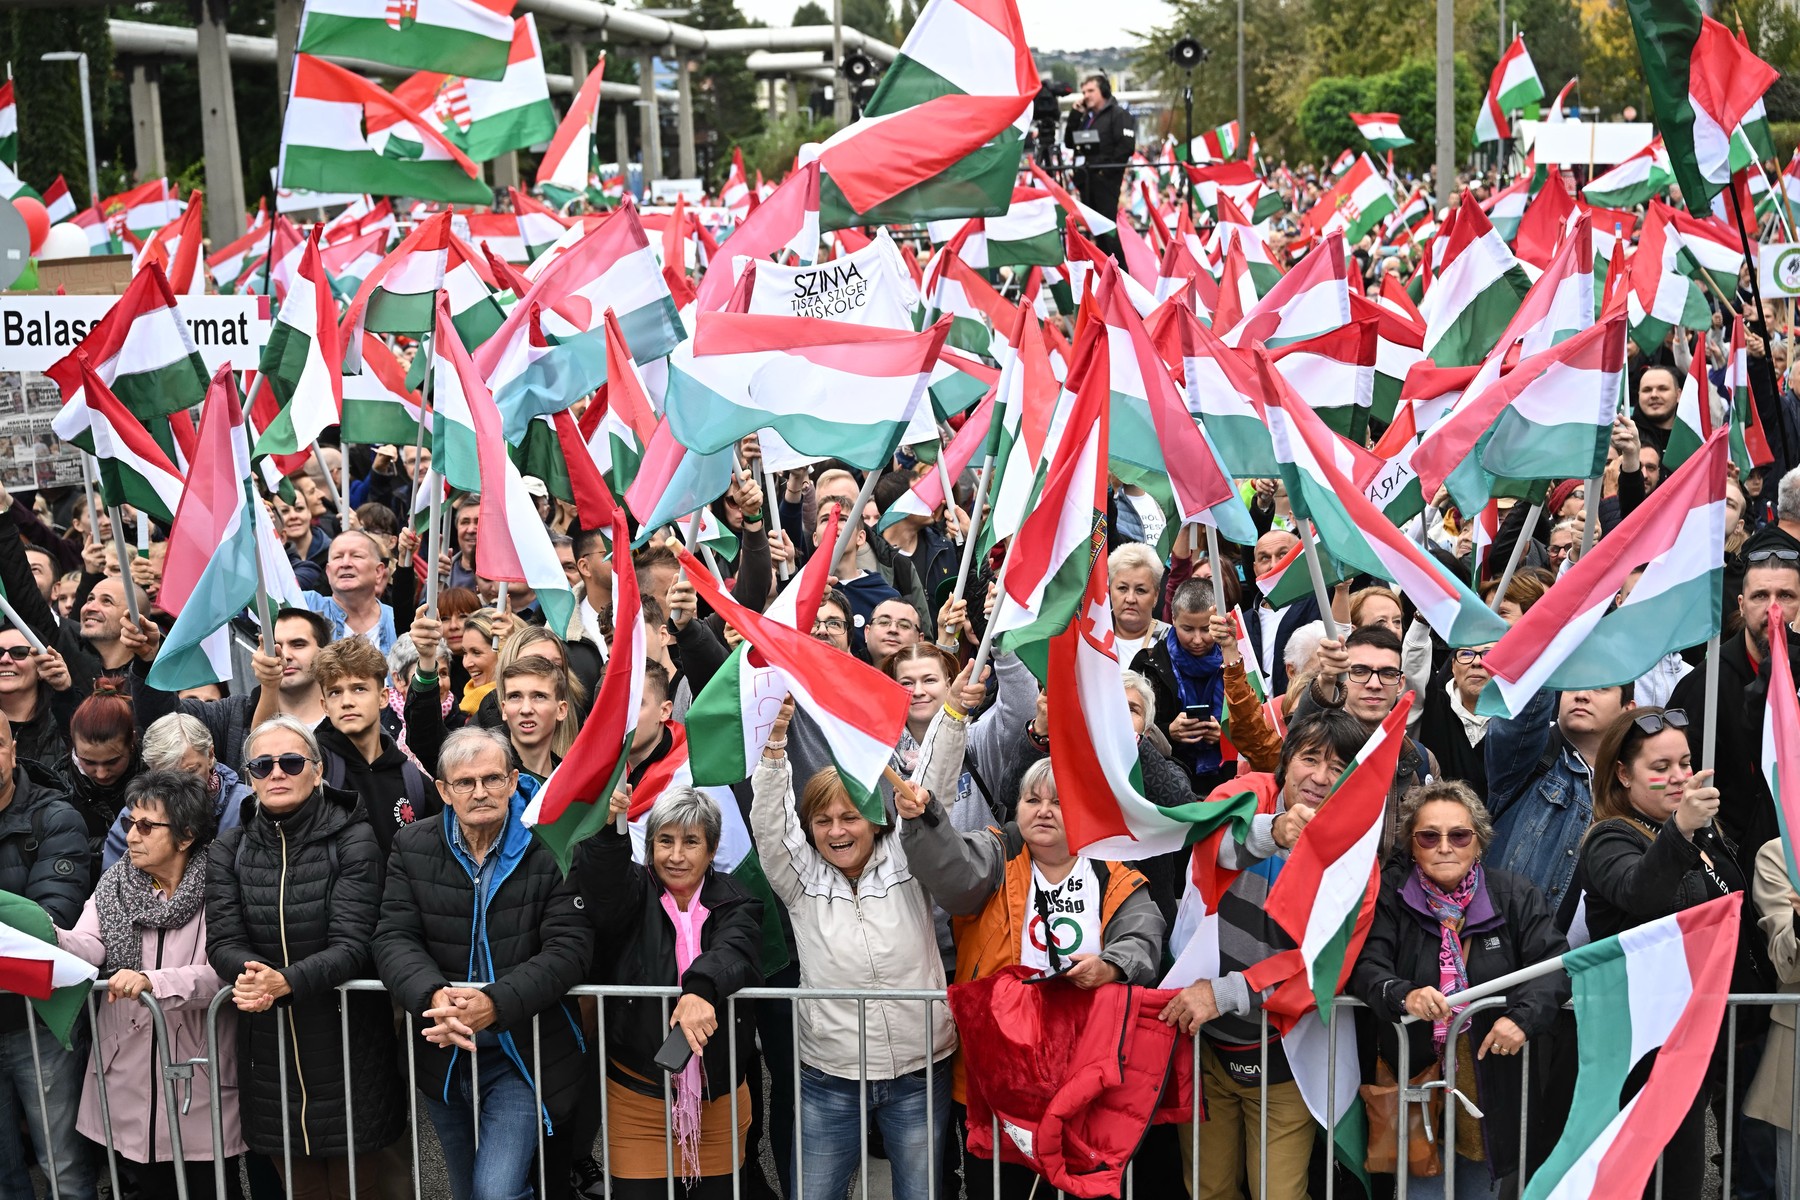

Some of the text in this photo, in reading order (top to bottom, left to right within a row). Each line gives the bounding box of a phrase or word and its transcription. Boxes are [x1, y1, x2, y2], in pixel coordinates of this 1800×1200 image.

[794, 262, 863, 298] SZINVA
[791, 280, 868, 311] TISZA SZIGET
[1067, 876, 1083, 892] és
[1230, 1061, 1261, 1074] NASA
